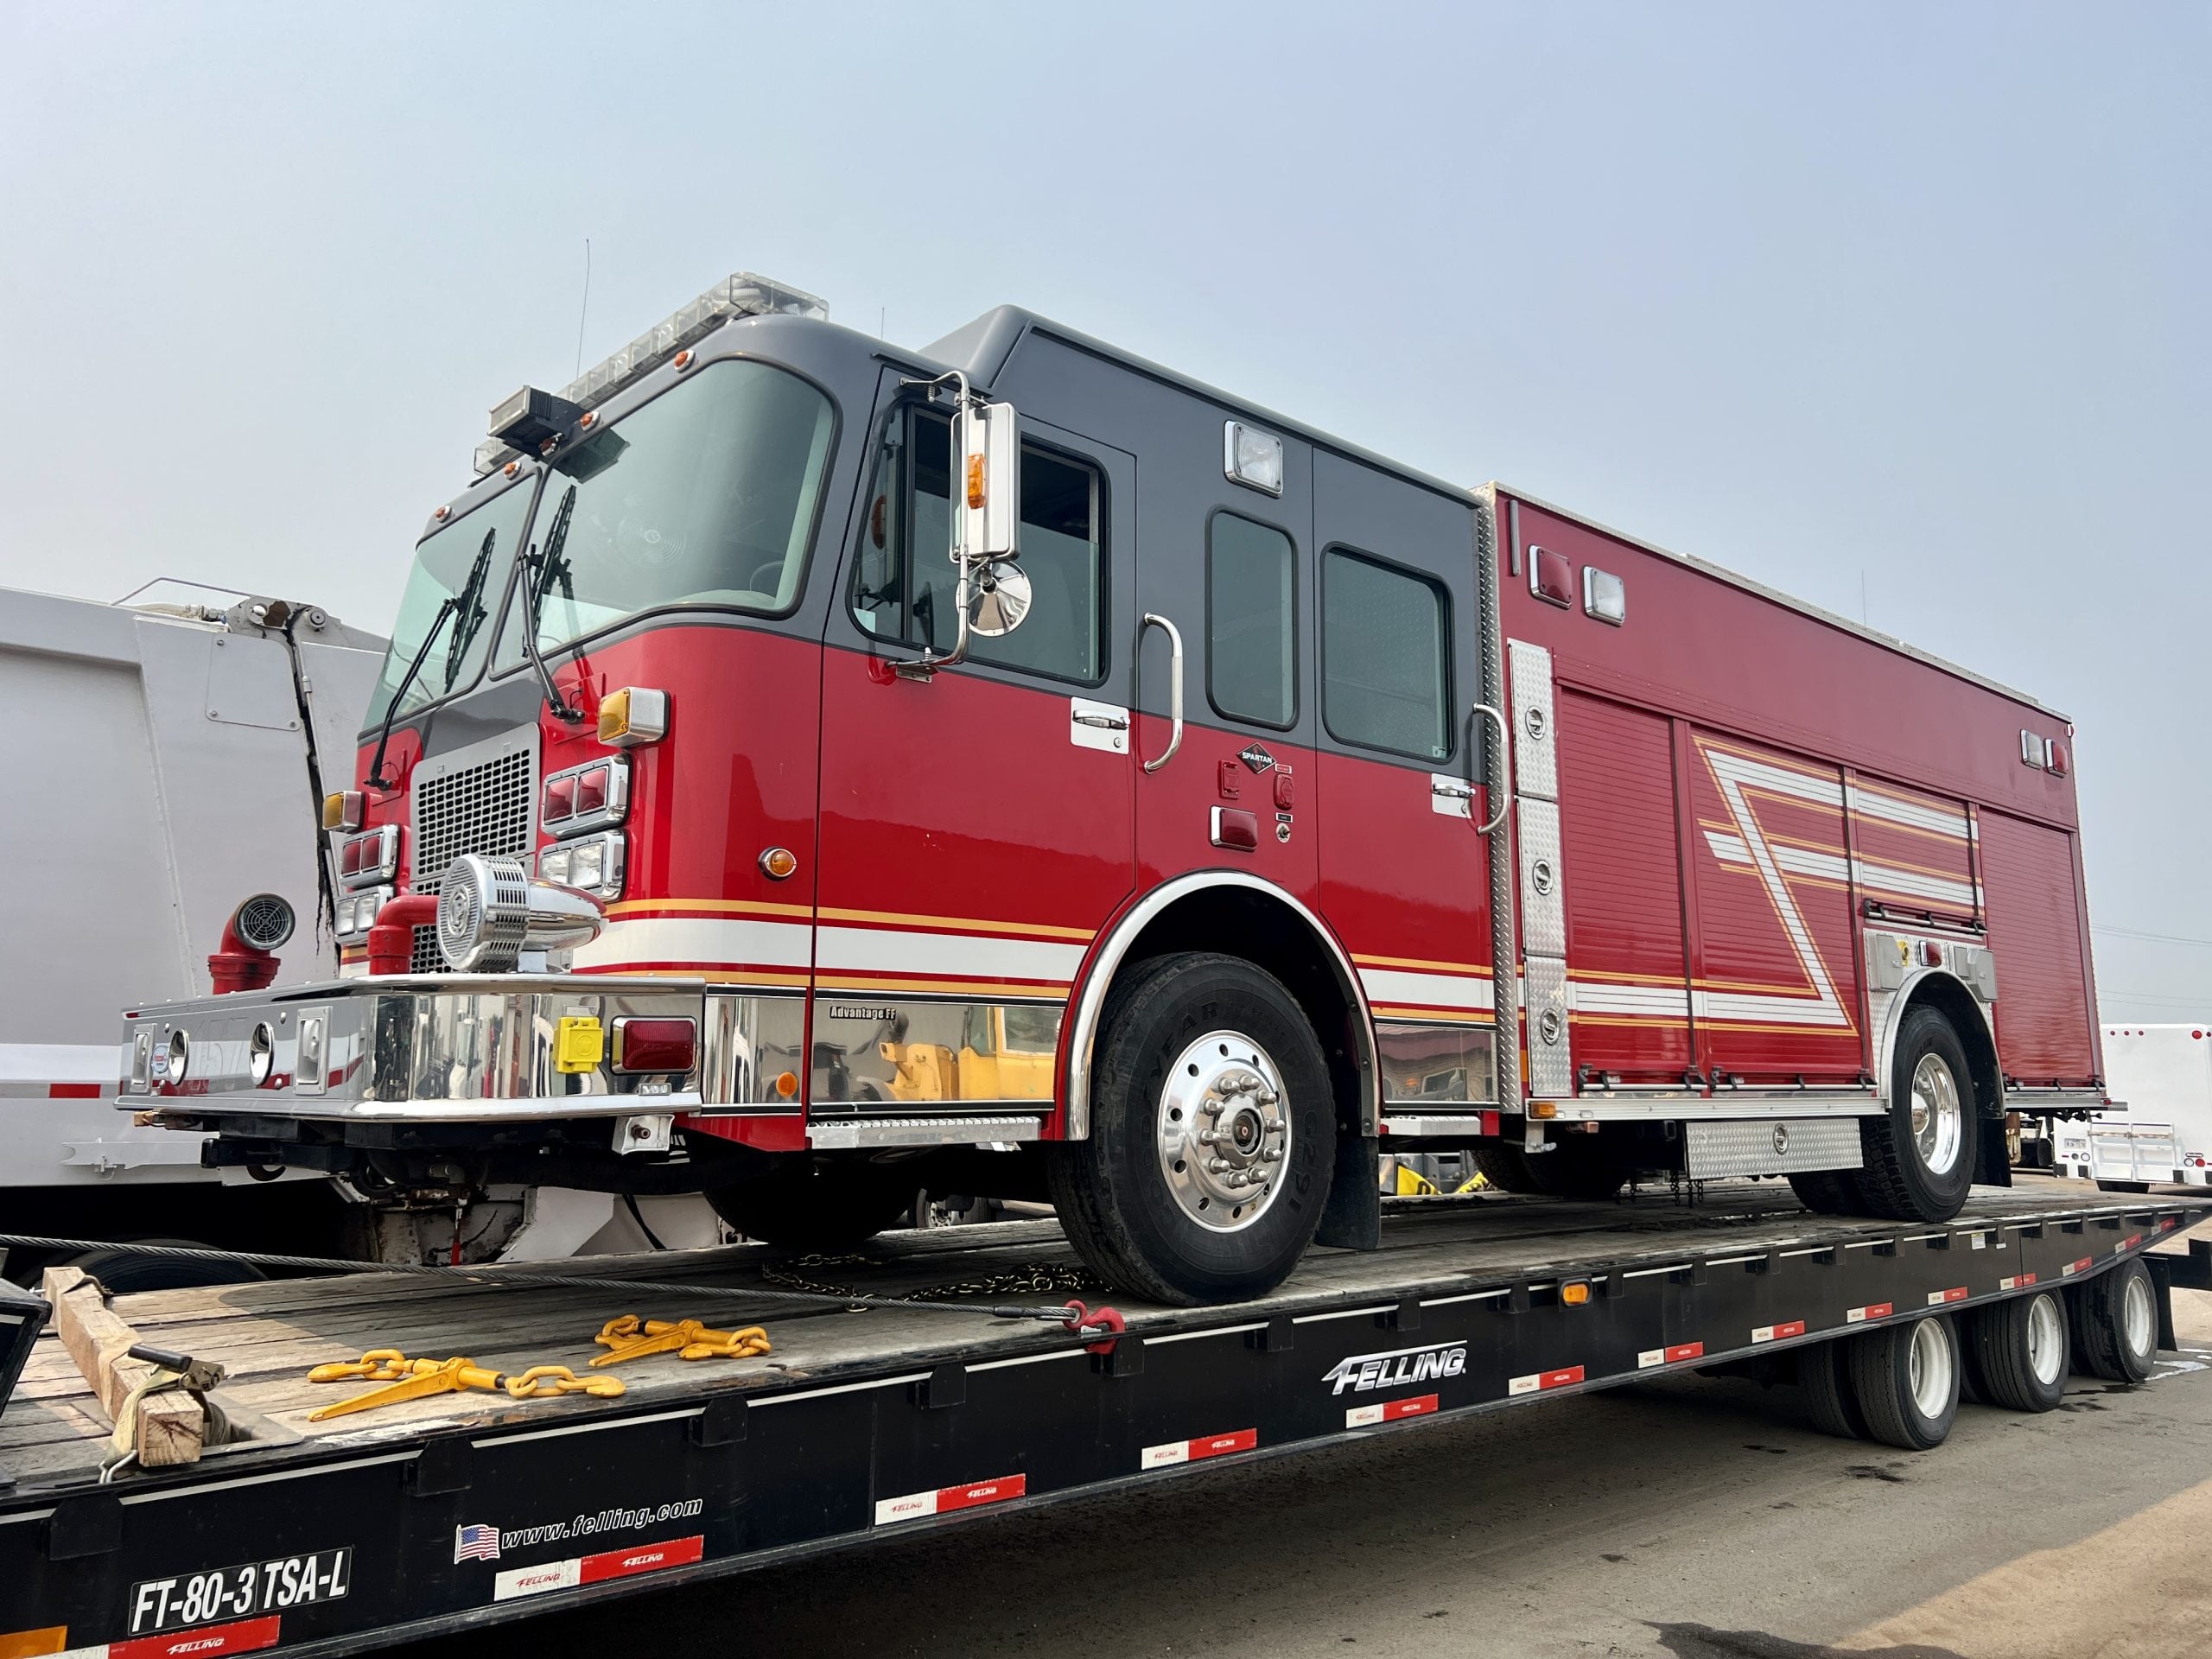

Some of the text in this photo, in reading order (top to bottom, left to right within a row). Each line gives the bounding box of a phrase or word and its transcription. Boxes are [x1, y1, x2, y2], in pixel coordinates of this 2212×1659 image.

[1242, 752, 1273, 764] SPARTAN
[830, 1006, 896, 1020] Advantage FF
[1321, 1340, 1467, 1395] FELLING
[502, 1499, 703, 1549] www.felling.com
[621, 1553, 664, 1567] FELLING
[517, 1573, 562, 1587] FELLING
[132, 1551, 346, 1633] FT-80-3 TSA-L
[166, 1637, 225, 1656] FELLING
